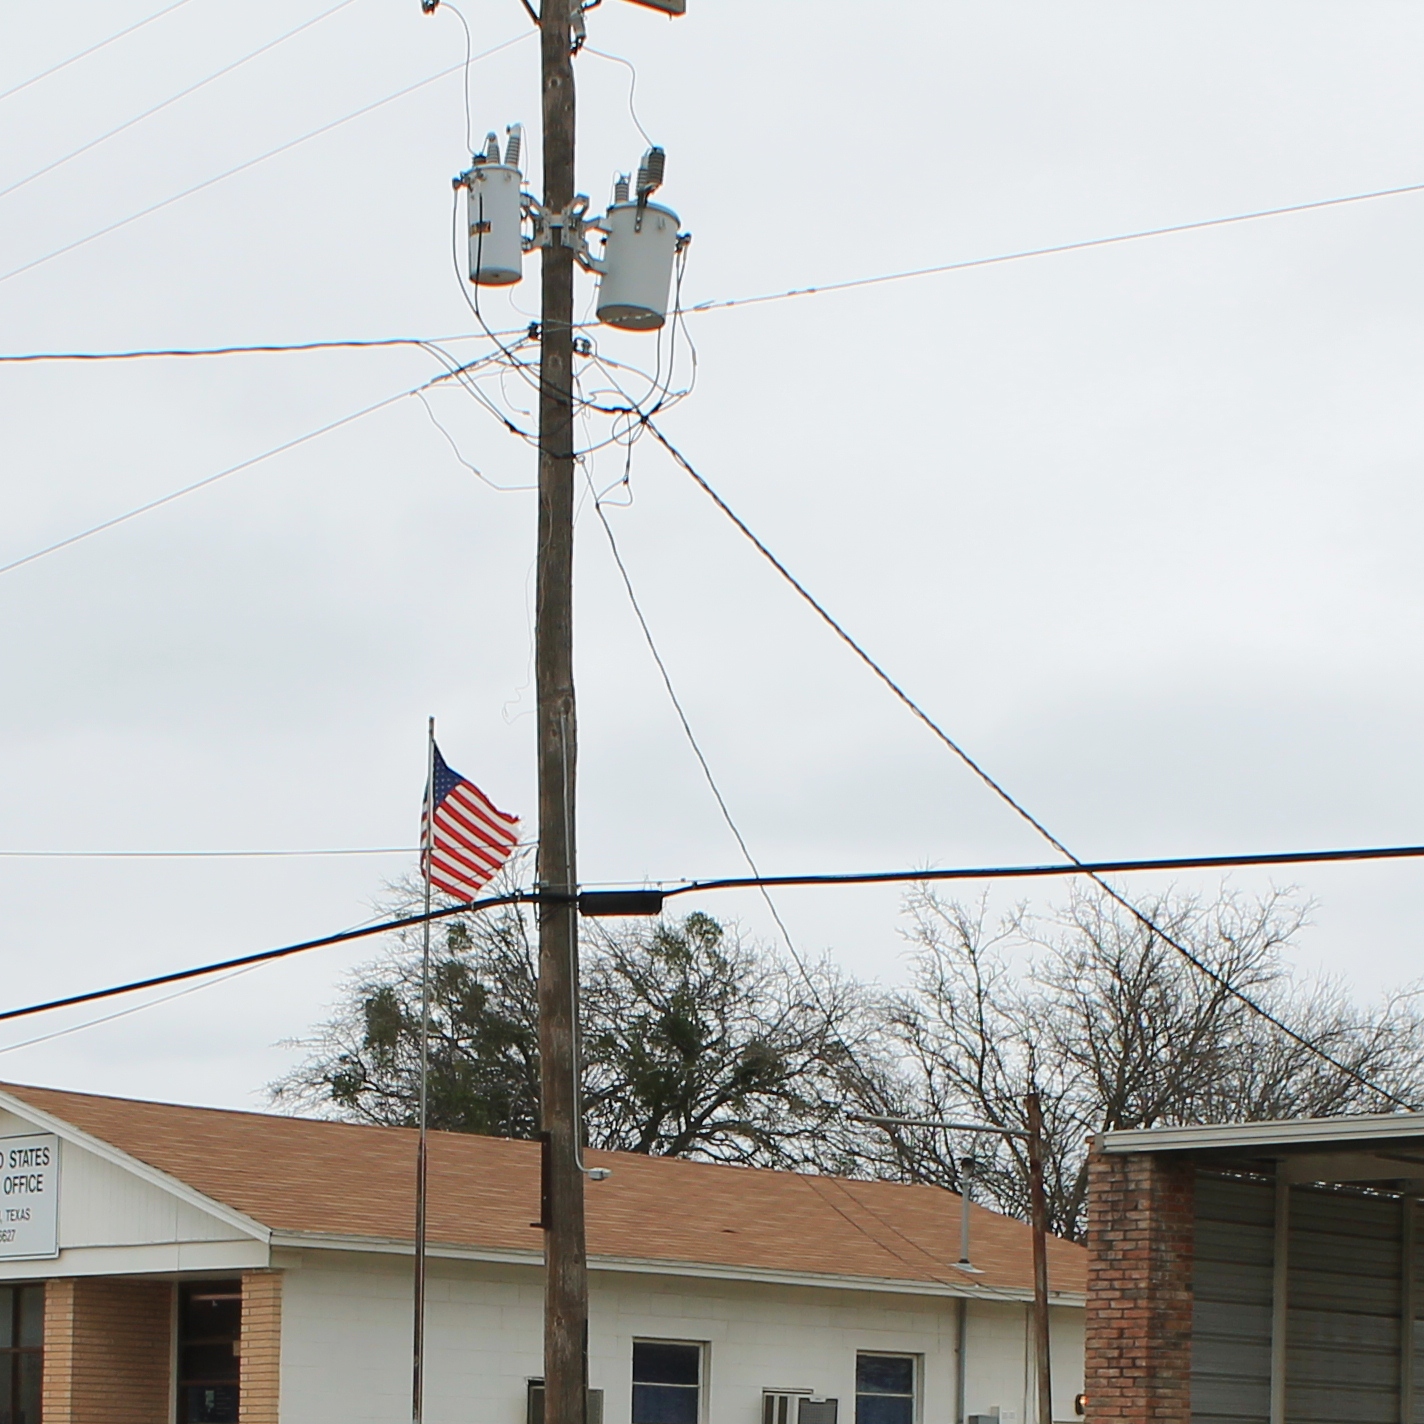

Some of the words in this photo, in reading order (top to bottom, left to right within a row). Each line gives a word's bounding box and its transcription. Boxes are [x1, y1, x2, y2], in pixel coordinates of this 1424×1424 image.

[9, 1147, 50, 1169] STATES
[4, 1173, 43, 1195] OFFICE
[6, 1208, 31, 1221] TEXAS
